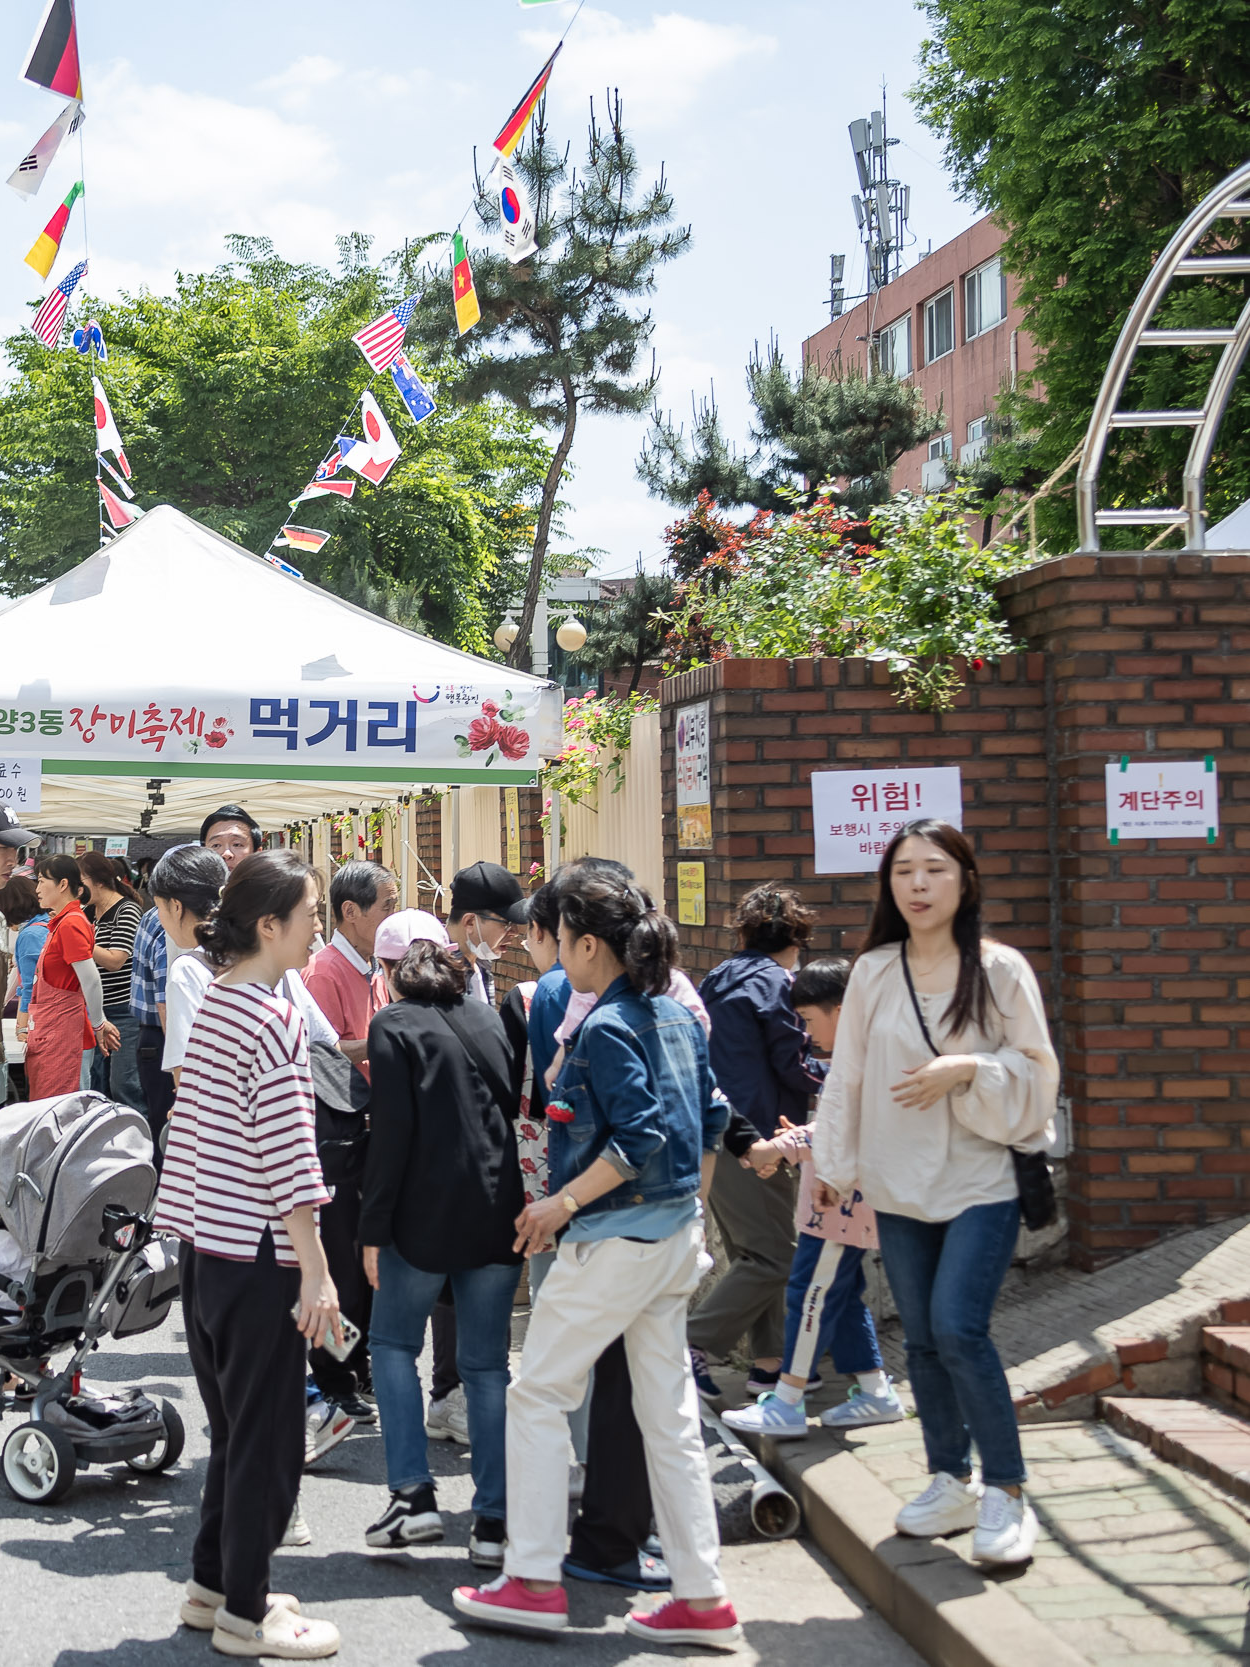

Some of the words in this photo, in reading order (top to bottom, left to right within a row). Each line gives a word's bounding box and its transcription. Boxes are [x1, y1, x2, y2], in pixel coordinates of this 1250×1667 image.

[69, 702, 206, 753] 장미축제
[250, 698, 417, 753] 먹거리
[851, 782, 921, 812] 위험!
[1118, 789, 1204, 811] 계단주의
[829, 822, 871, 837] 보행시
